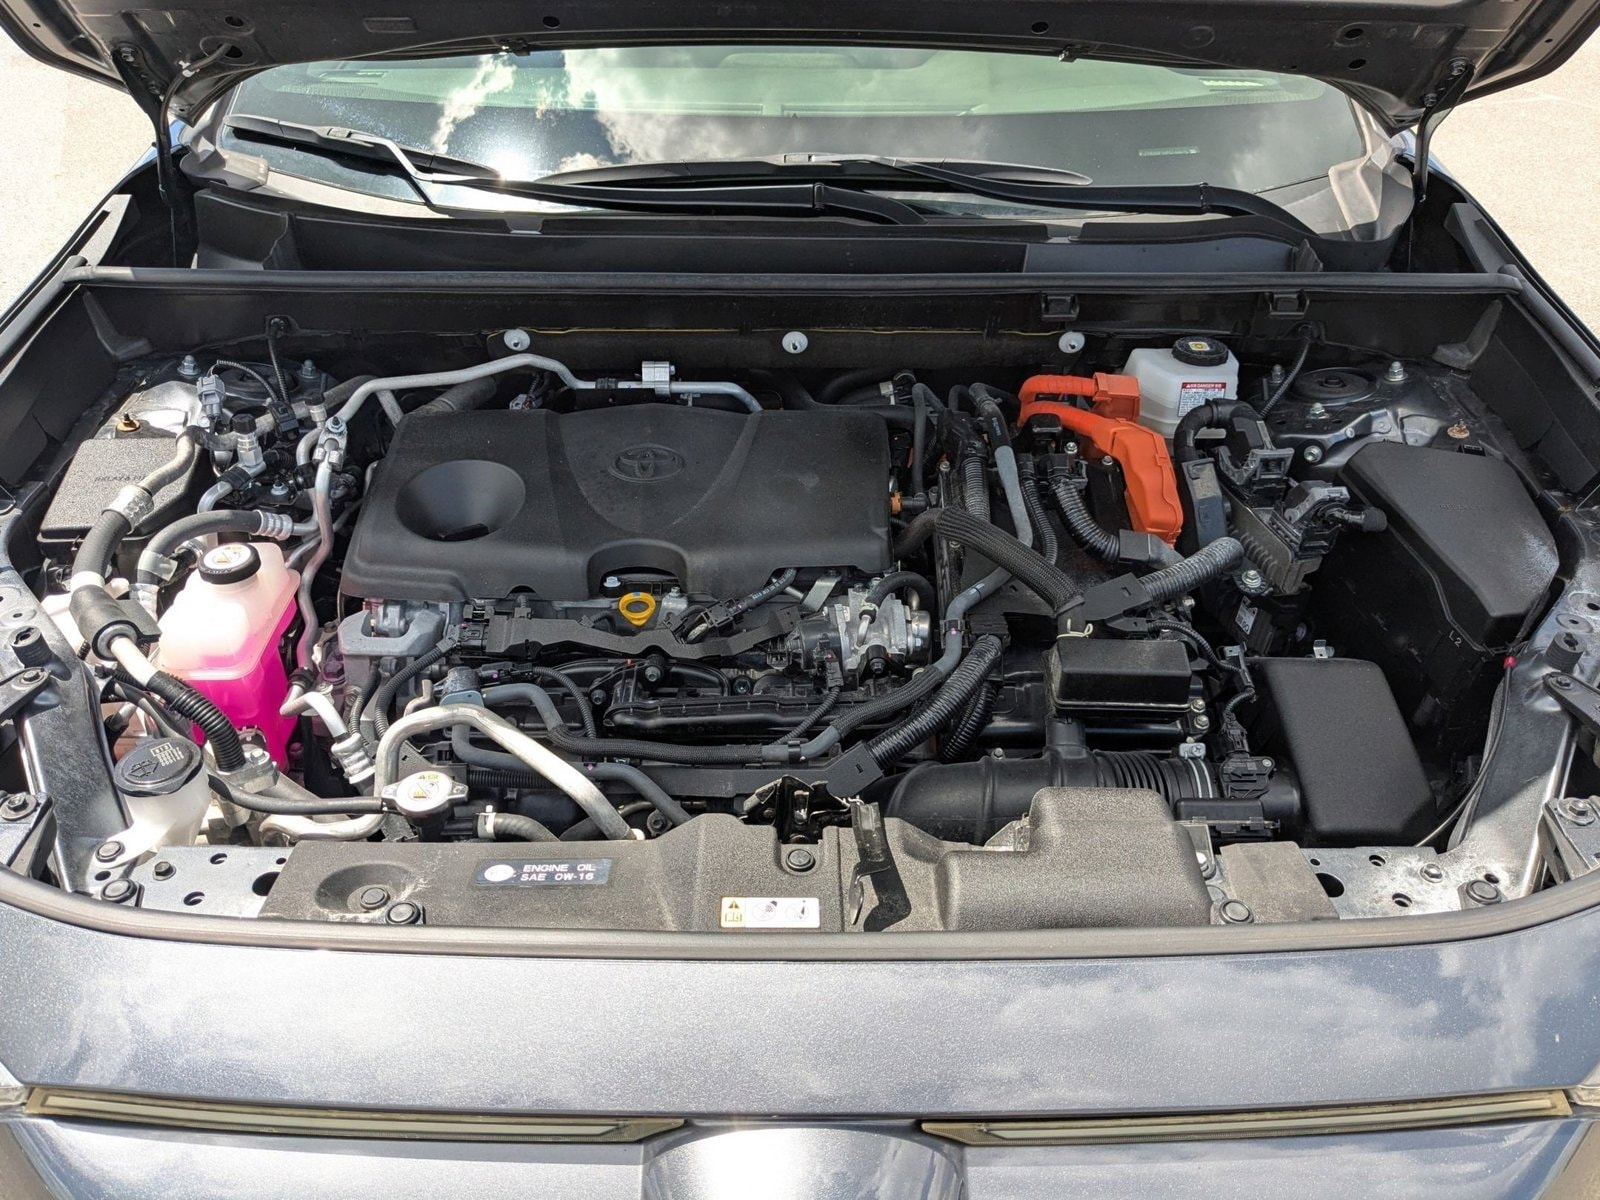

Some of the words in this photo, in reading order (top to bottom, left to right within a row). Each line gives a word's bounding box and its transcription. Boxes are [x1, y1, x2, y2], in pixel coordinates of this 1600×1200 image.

[522, 864, 570, 872] ENGINE
[576, 864, 597, 872] OIL
[520, 873, 548, 881] SAE
